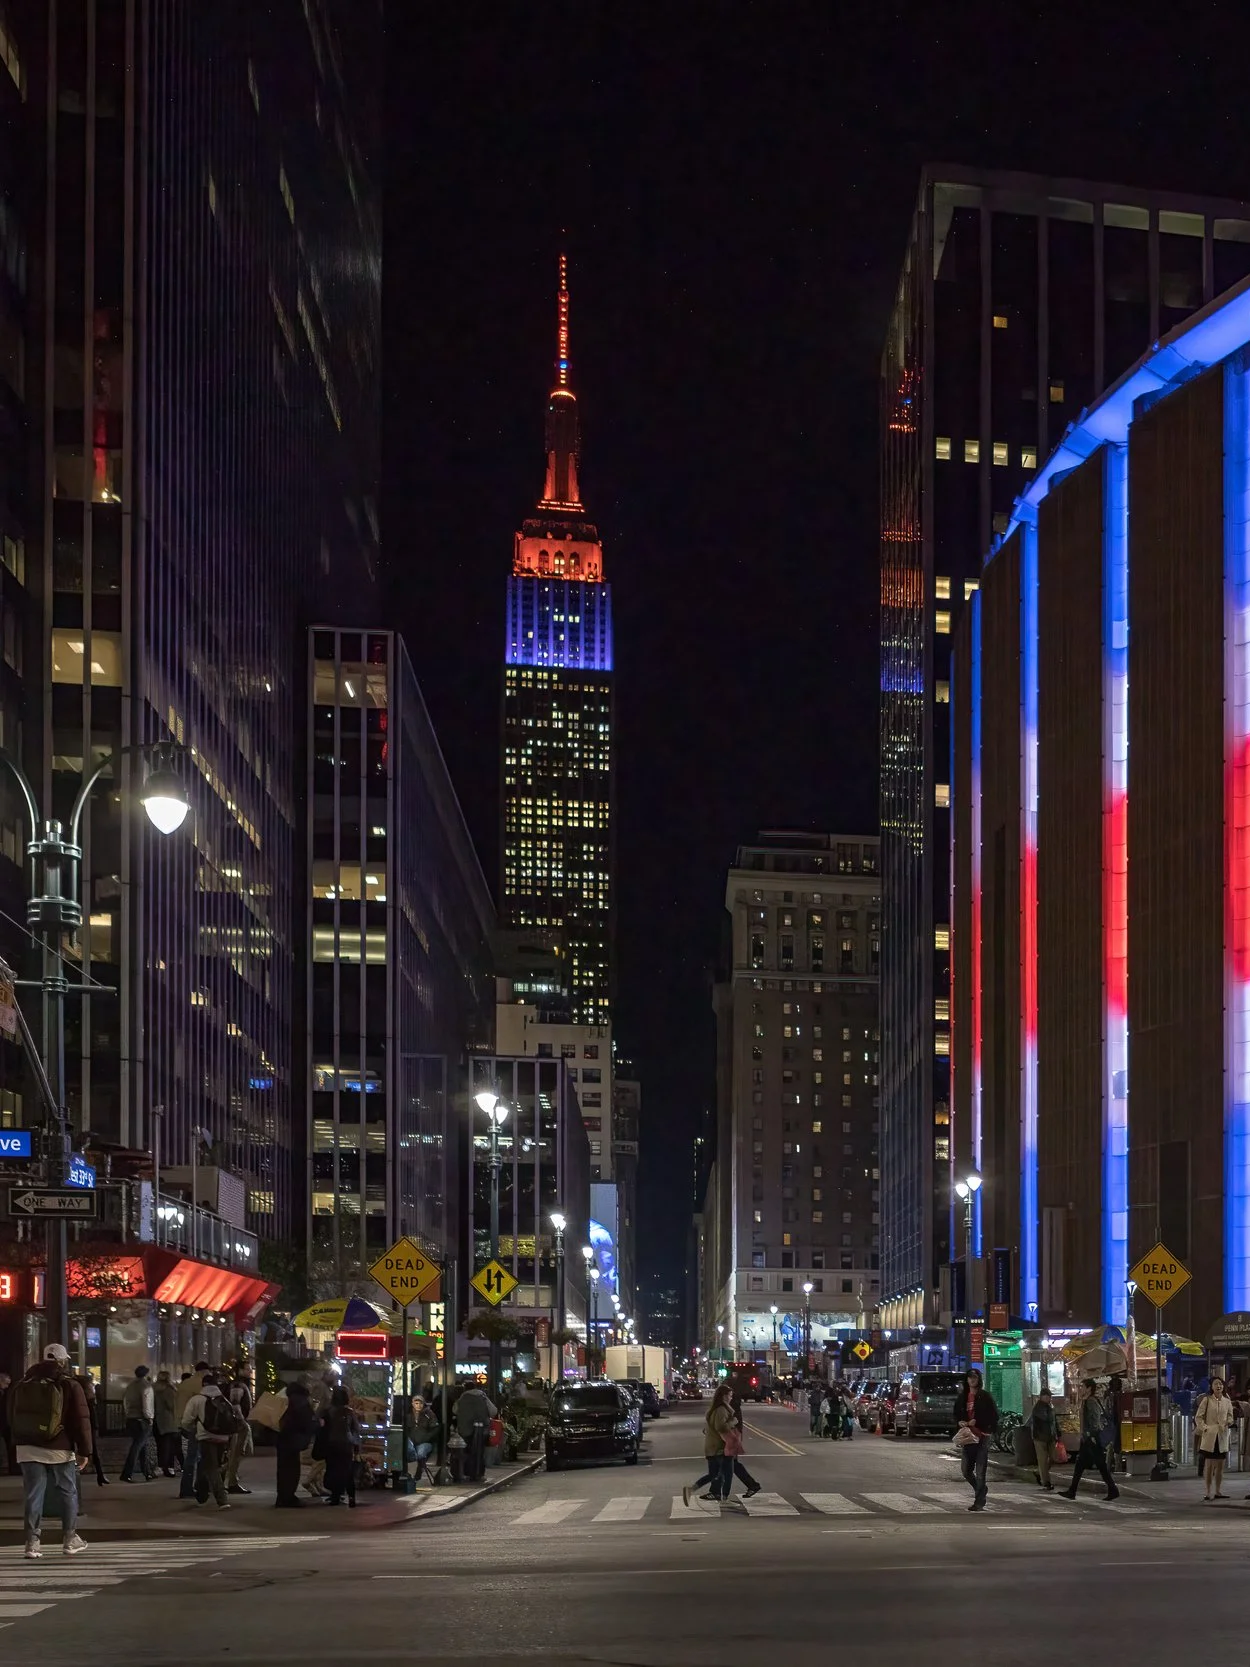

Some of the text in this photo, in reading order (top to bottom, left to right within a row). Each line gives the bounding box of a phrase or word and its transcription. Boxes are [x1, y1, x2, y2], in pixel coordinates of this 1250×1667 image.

[0, 1138, 21, 1151] ve
[23, 1197, 84, 1207] ONE WAY
[385, 1258, 425, 1271] DEAD
[1142, 1263, 1178, 1275] DEAD
[390, 1276, 419, 1288] END
[1147, 1279, 1172, 1291] END
[1224, 1324, 1239, 1332] PENN
[455, 1363, 488, 1375] PARK
